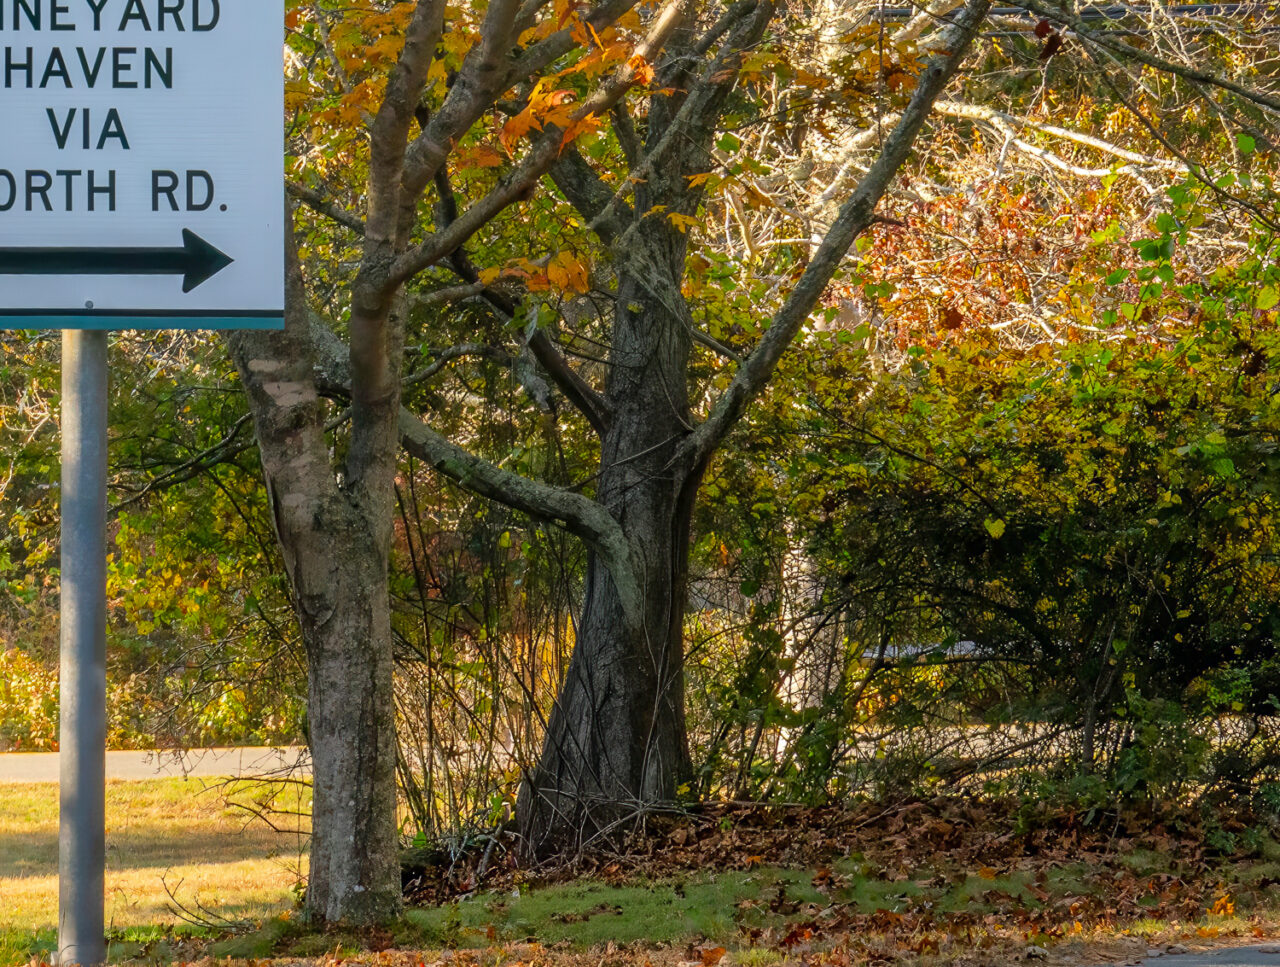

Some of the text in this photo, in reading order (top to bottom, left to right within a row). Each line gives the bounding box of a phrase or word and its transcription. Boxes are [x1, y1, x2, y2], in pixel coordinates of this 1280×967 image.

[4, 46, 173, 89] HAVEN
[45, 107, 131, 150] VIA
[151, 169, 228, 212] RD.
